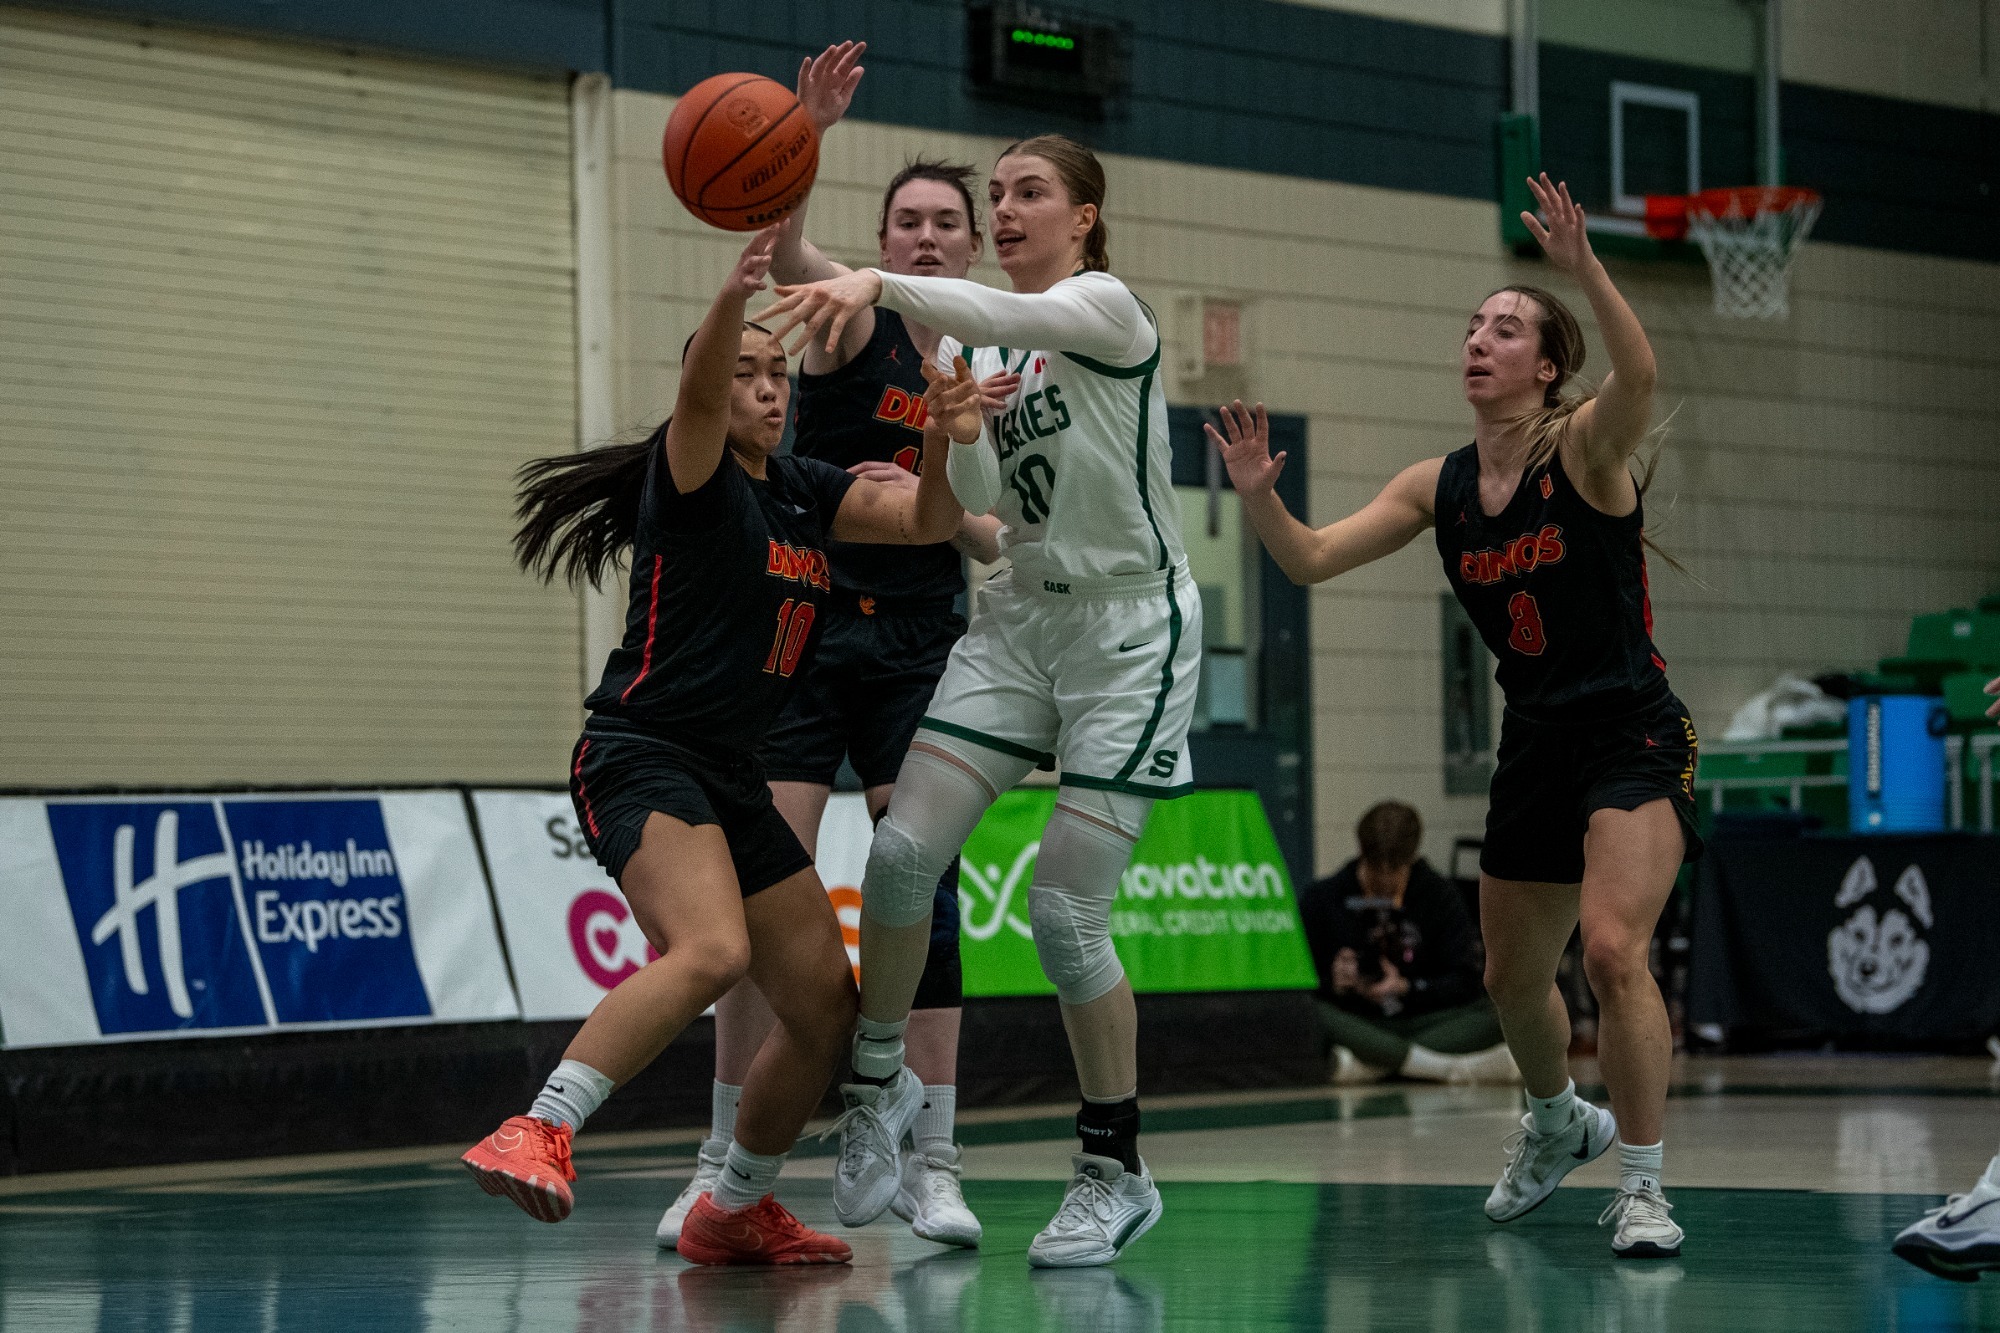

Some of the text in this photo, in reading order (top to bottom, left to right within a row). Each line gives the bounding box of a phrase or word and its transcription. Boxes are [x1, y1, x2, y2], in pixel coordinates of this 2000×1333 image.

[993, 384, 1072, 462] SKIES
[1460, 524, 1567, 585] DINOS
[1043, 580, 1071, 595] SASK
[762, 598, 816, 677] 10
[1508, 590, 1547, 656] 8
[1148, 749, 1178, 779] S
[242, 838, 395, 887] Holiday Inn
[255, 890, 401, 953] Express
